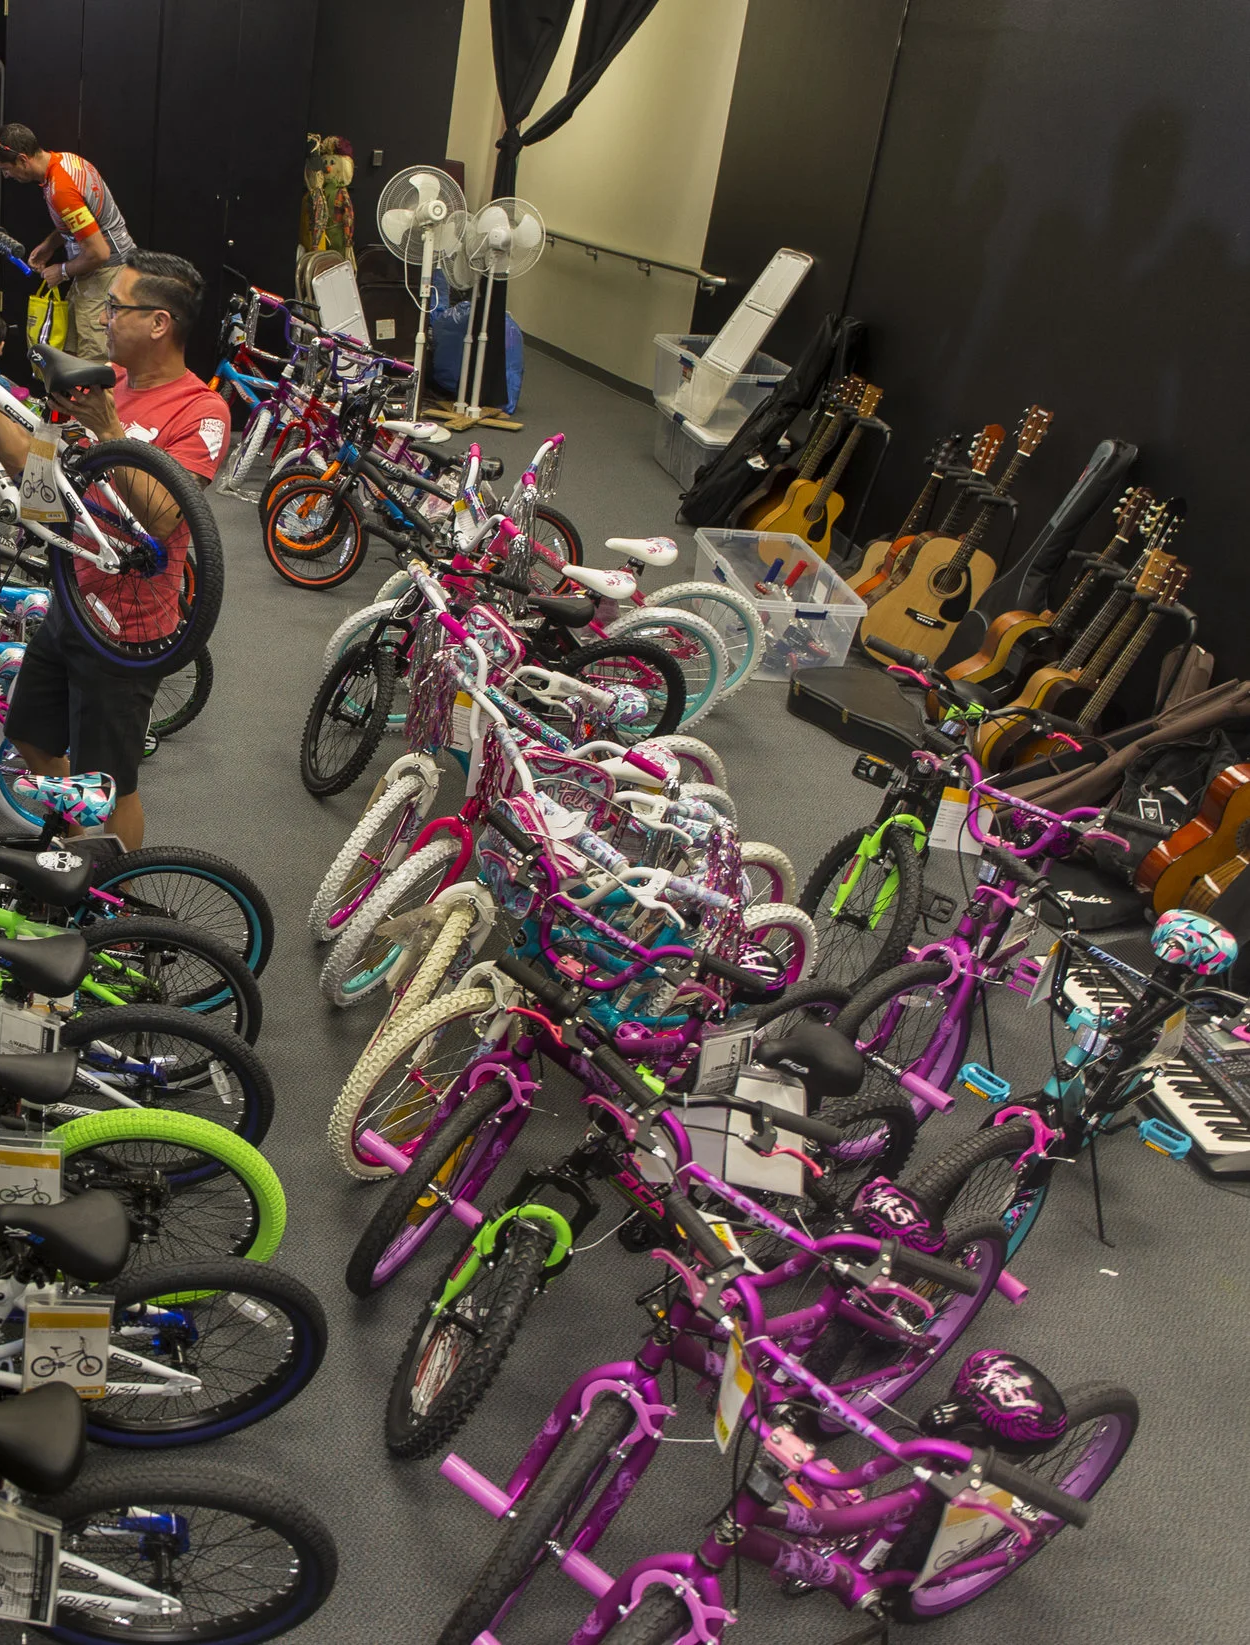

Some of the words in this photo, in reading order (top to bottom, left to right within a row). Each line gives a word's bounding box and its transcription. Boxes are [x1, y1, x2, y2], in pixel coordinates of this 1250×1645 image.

[6, 406, 34, 431] KENT
[558, 782, 595, 812] talk
[1057, 891, 1111, 904] Fender
[63, 1563, 97, 1578] KENT
